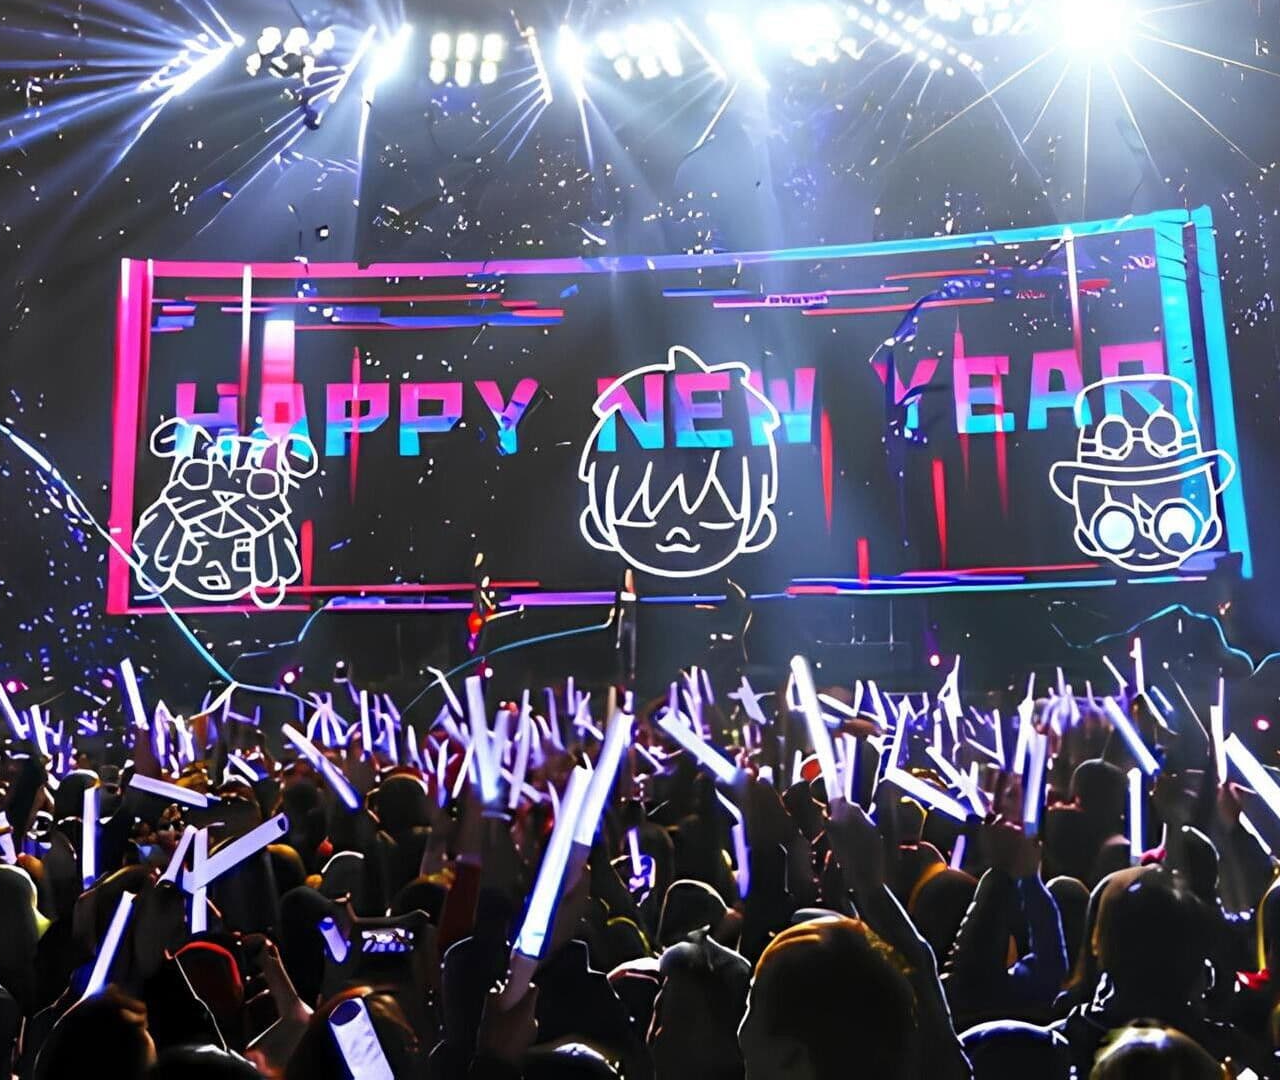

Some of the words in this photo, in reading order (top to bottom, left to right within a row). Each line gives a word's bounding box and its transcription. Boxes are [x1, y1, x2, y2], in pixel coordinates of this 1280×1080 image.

[176, 378, 539, 459] HAPPY
[597, 368, 817, 453] NEW
[873, 340, 1168, 433] YEAR
